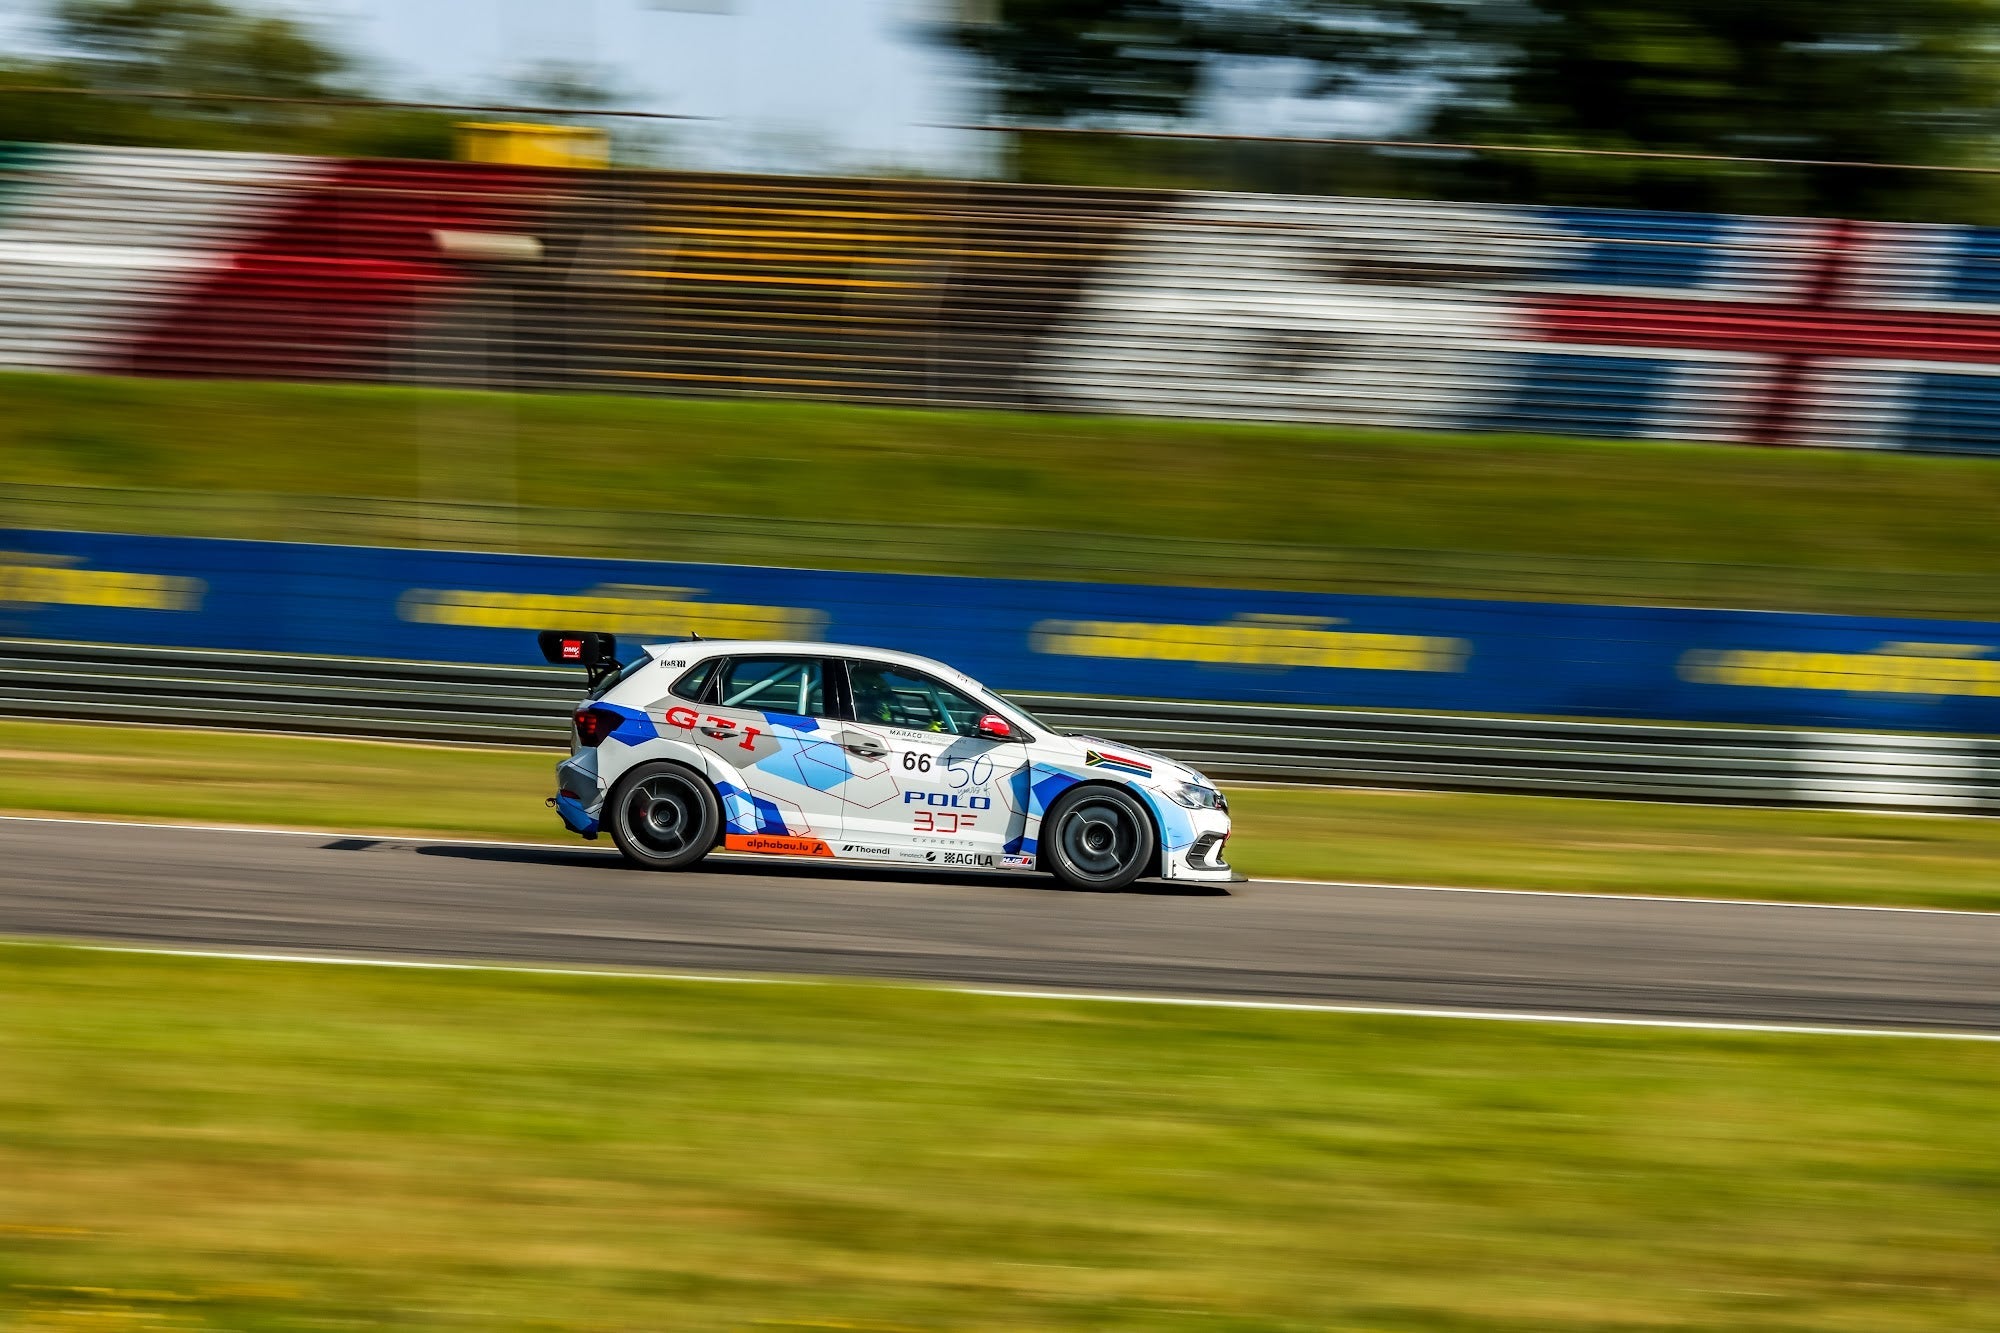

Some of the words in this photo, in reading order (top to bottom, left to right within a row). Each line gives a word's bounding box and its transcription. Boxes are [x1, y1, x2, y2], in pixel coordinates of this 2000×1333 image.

[660, 659, 676, 667] H&R
[665, 706, 761, 752] GTI
[889, 729, 922, 739] MARACO
[903, 751, 932, 773] 66
[946, 753, 994, 788] 50
[904, 791, 991, 810] POLO
[747, 839, 809, 851] alphabau.lu
[912, 837, 974, 847] EXPERTS
[955, 853, 993, 866] AGILA
